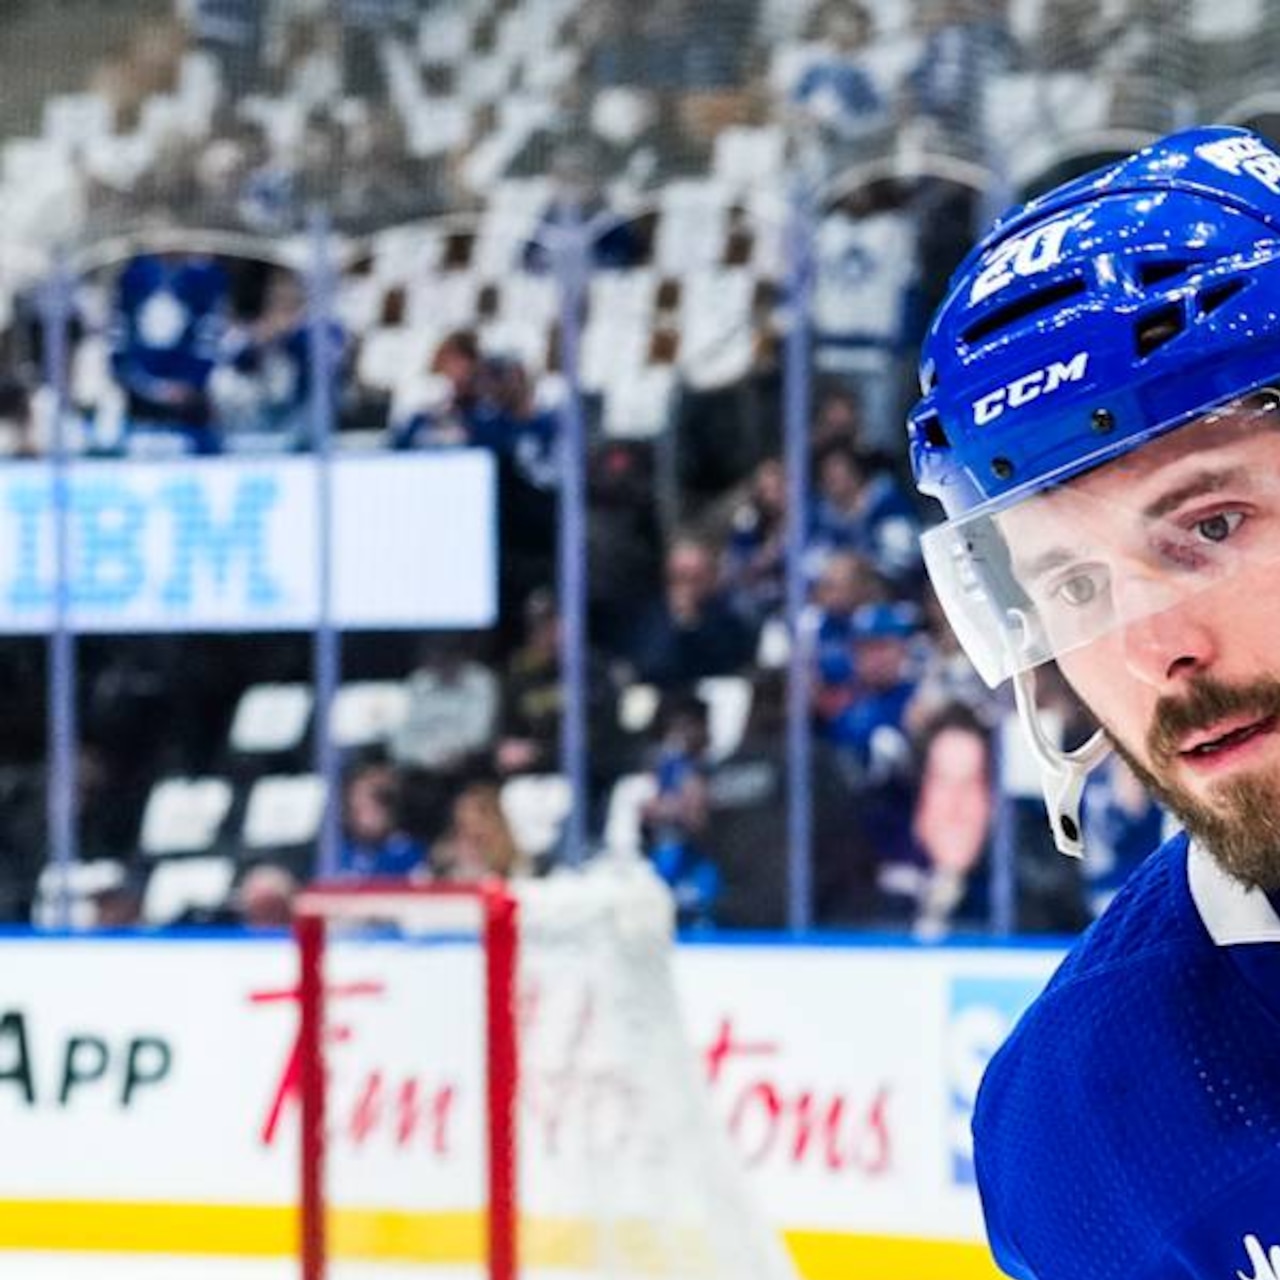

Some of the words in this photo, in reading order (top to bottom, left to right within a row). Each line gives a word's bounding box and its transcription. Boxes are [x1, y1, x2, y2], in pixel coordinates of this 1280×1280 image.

[970, 218, 1074, 305] 20
[972, 351, 1089, 426] CCM
[5, 475, 286, 611] IBM
[247, 981, 457, 1155] Tm
